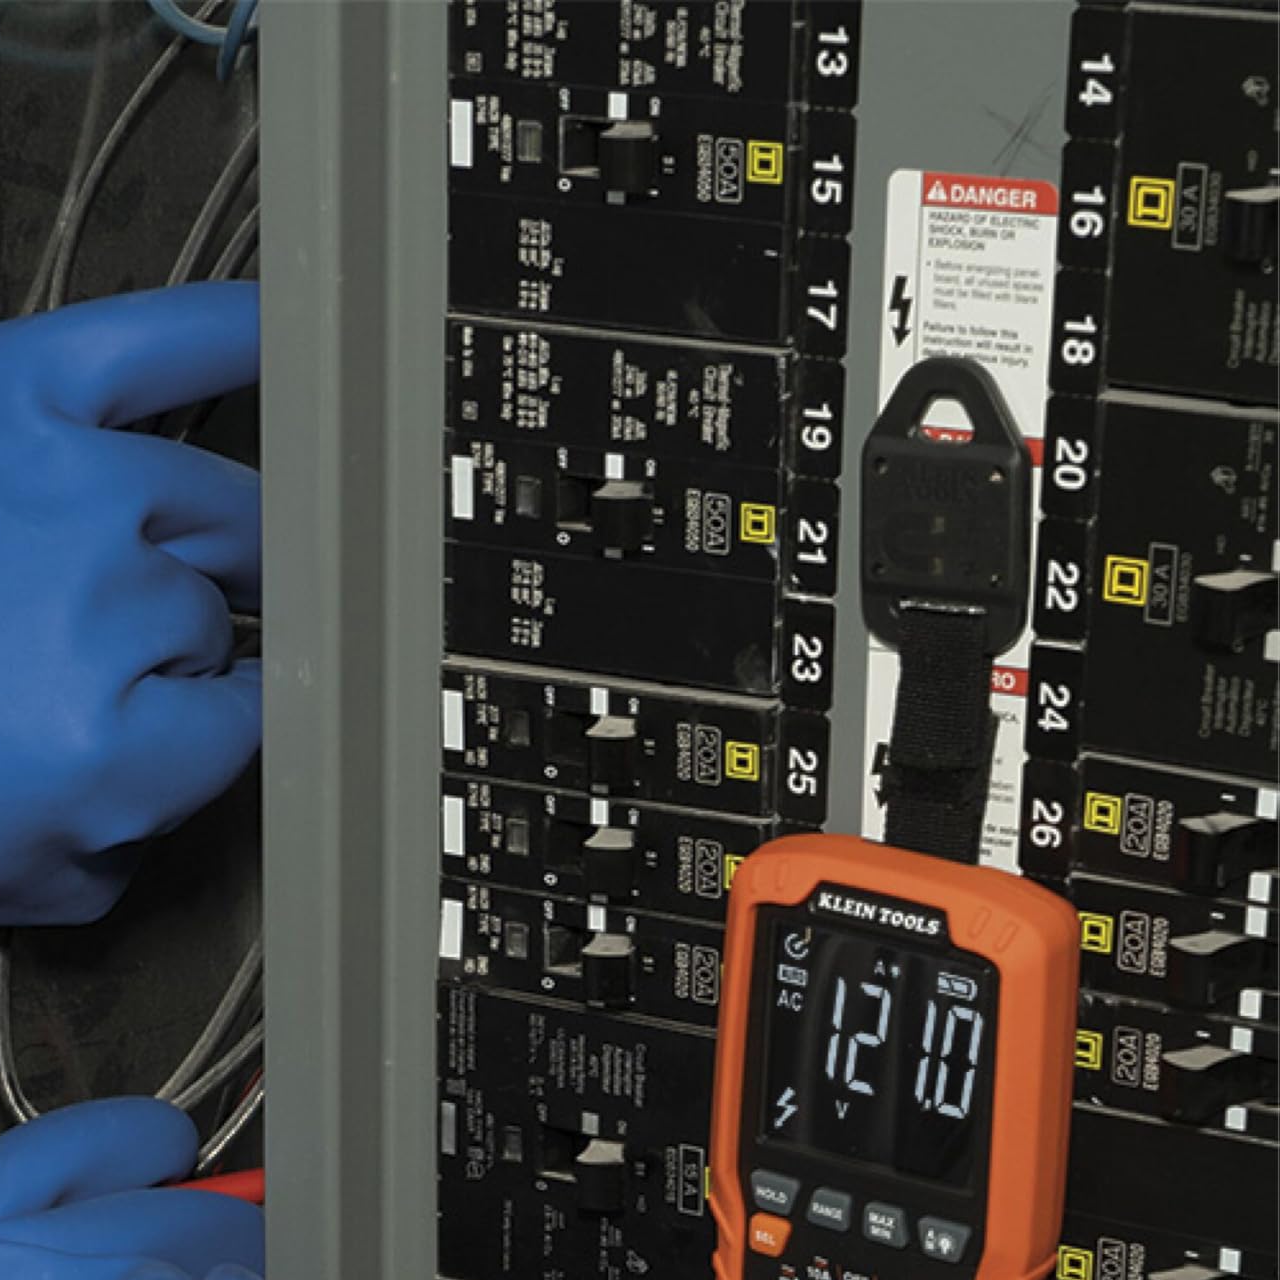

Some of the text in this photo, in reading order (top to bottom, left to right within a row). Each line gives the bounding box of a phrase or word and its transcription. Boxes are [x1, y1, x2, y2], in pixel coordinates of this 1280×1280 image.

[817, 26, 850, 77] 13
[1078, 53, 1114, 105] 14
[719, 142, 738, 197] 50A
[811, 154, 844, 204] 15
[950, 184, 1037, 209] DANGER
[1069, 186, 1105, 238] 16
[1178, 184, 1199, 231] 30 A
[807, 280, 840, 330] 17
[1061, 315, 1097, 366] 18
[801, 402, 832, 450] 19
[1053, 437, 1088, 490] 20
[707, 499, 725, 548] 50A
[796, 521, 828, 565] 21
[1045, 560, 1080, 611] 22
[1151, 563, 1171, 608] 30 A
[792, 635, 822, 682] 23
[1038, 682, 1071, 732] 24
[698, 731, 717, 778] 20A
[788, 749, 818, 797] 25
[1030, 799, 1063, 848] 26
[1126, 801, 1148, 849] 20A
[700, 845, 716, 893] 20A
[818, 892, 941, 936] KLEIN TOOLS
[1121, 918, 1143, 965] 20A
[697, 951, 715, 998] 20A
[777, 988, 804, 1012] AC
[825, 975, 984, 1119] 121.0
[1116, 1035, 1138, 1080] 20A
[835, 1100, 850, 1120] V
[756, 1186, 786, 1204] HOLD
[812, 1203, 843, 1222] RANGE
